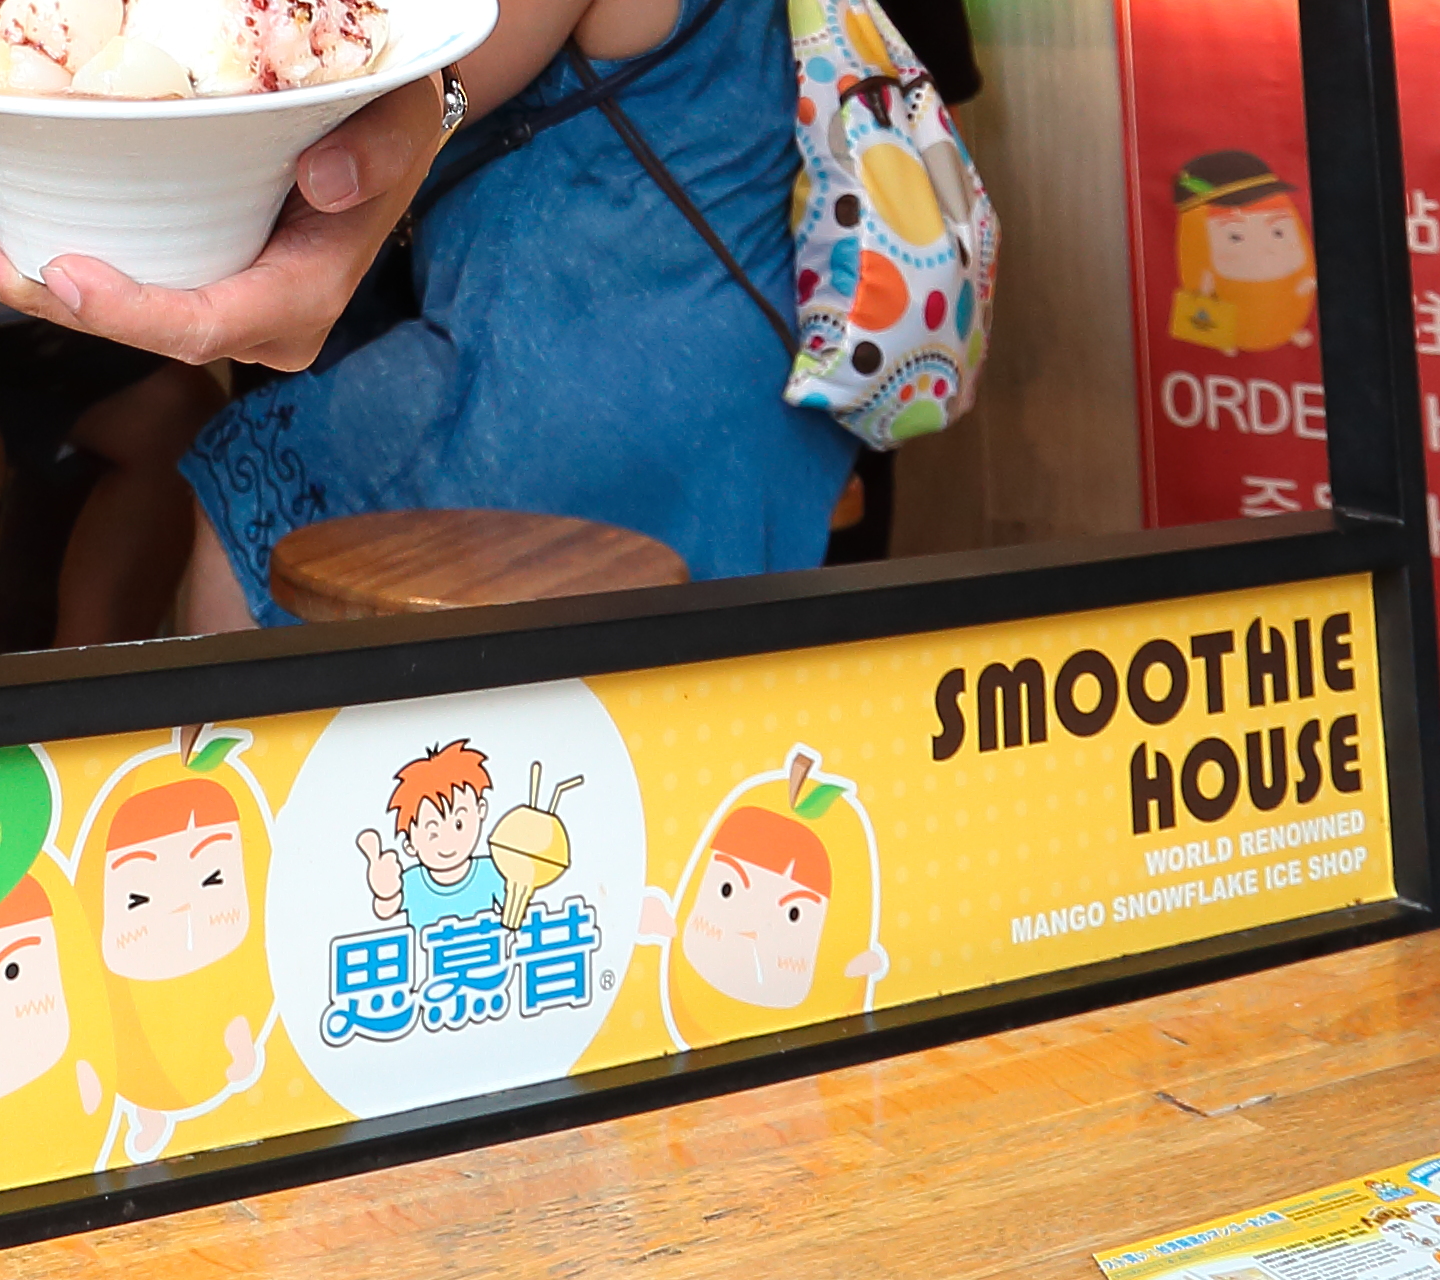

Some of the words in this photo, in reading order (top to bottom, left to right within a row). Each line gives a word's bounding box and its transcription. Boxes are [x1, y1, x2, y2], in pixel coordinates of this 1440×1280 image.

[931, 611, 1357, 762] SMOOTHIE
[1129, 713, 1363, 837] HOUSE
[1011, 900, 1106, 946] MANGO
[1113, 869, 1259, 922] SNOWFLAKE
[1265, 859, 1302, 890] ICE
[1308, 845, 1369, 882] SHOP
[1144, 836, 1234, 878] WORLD
[1240, 809, 1366, 858] RENOWNED
[323, 900, 600, 1042] 思慕昔
